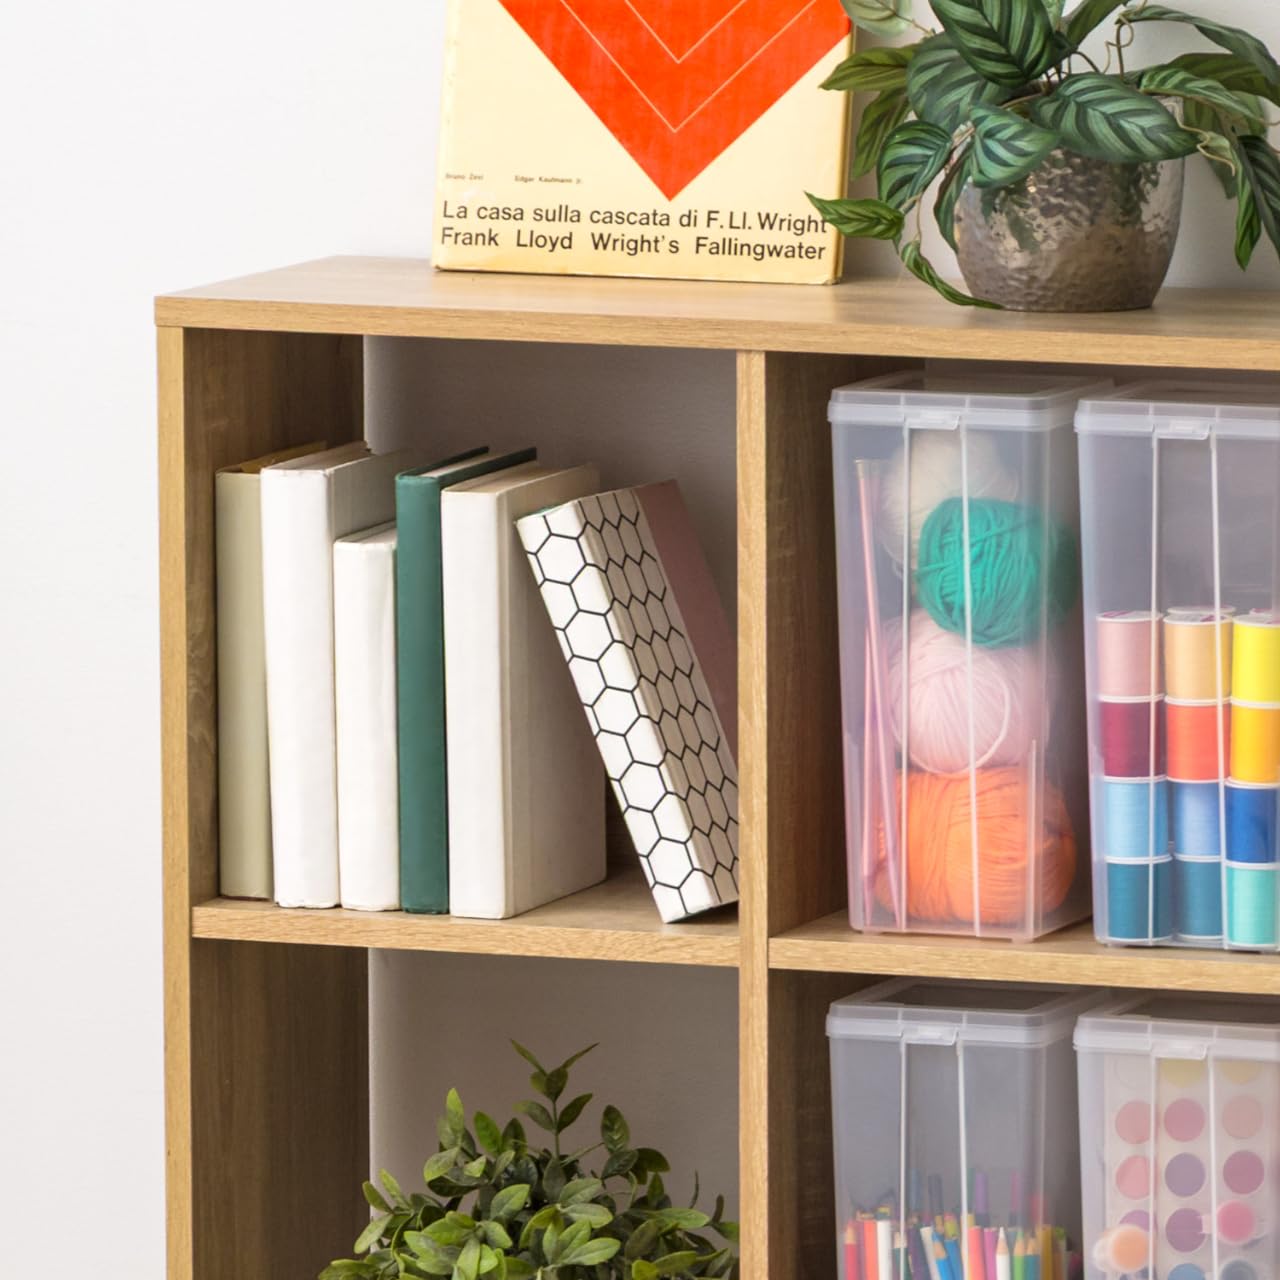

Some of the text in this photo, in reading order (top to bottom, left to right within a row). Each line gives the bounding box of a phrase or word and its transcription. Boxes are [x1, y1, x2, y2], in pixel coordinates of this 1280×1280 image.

[443, 200, 468, 220] La
[476, 206, 524, 221] casa
[532, 204, 581, 224] sulla
[589, 209, 670, 227] cascata
[679, 209, 698, 228] di
[757, 211, 827, 237] Wright
[441, 226, 827, 262] Frank Lloyd Wright's Fallingwater
